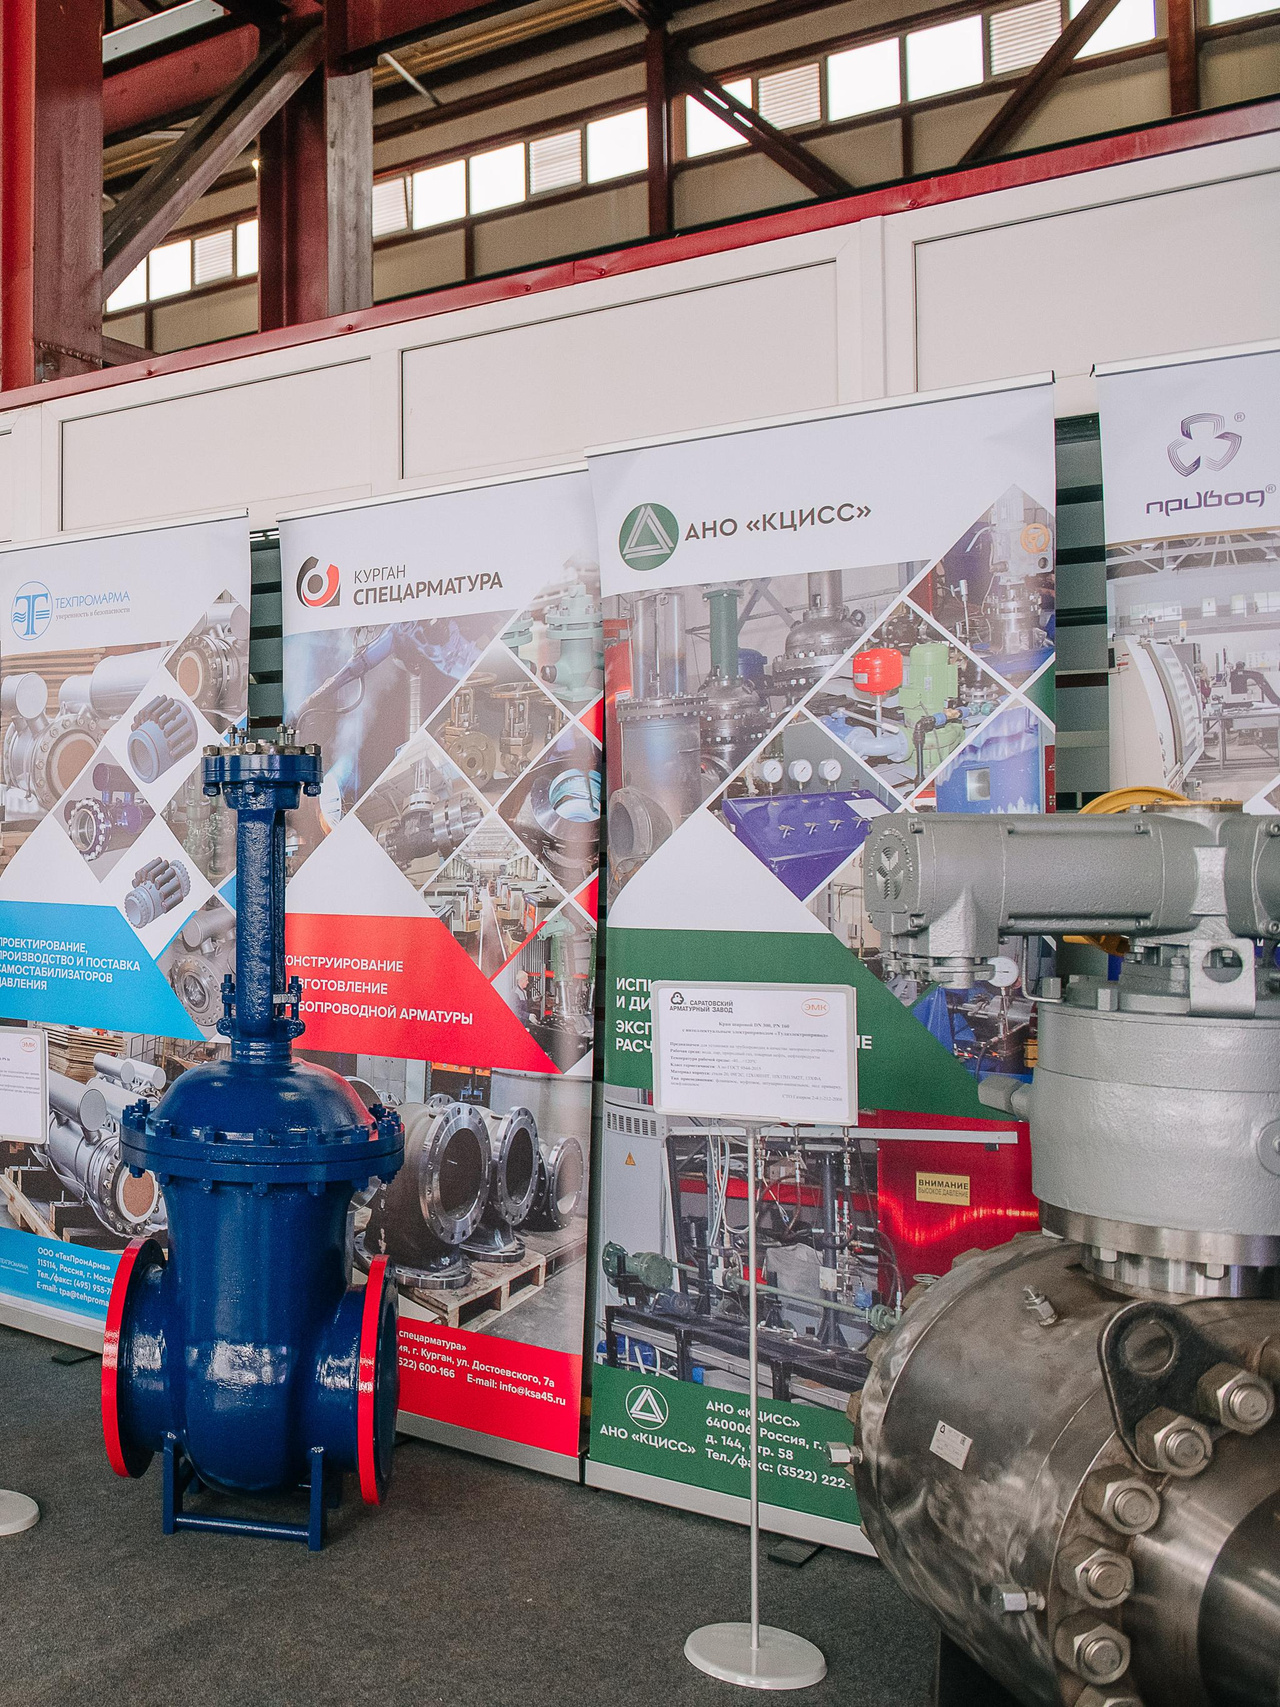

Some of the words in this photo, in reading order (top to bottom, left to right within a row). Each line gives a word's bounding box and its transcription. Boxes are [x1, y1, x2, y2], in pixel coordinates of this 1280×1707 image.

[685, 518, 738, 541] АНО
[746, 502, 872, 532] «КЦИСС»
[354, 564, 406, 584] КУРГАН
[353, 571, 503, 606] СПЕЦАРМАТУРА
[55, 590, 131, 609] ТЕХПРОМАРМА
[55, 611, 89, 621] уверенность
[94, 607, 131, 616] безопасности
[76, 957, 84, 967] И
[85, 957, 141, 971] ПОСТАВКА
[289, 976, 388, 995] ЗГОТОВЛЕНИЕ
[298, 1000, 397, 1019] БОПРОВОДНОЙ
[399, 1007, 473, 1025] АРМАТУРЫ
[616, 995, 625, 1009] И
[669, 1005, 710, 1013] АРМАТУРНЫЙ
[689, 999, 734, 1007] САРАТОВСКИЙ
[805, 1003, 827, 1011] ЭМК
[615, 1037, 653, 1053] РАСЧ
[918, 1179, 969, 1190] ВНИМАНИЕ
[918, 1186, 941, 1196] ВЫСОКОЕ
[942, 1188, 969, 1198] ДАВЛЕНИЕ
[37, 1246, 54, 1257] ООО
[55, 1252, 111, 1271] «ТехПромАрма»
[37, 1258, 58, 1271] 115114,
[59, 1263, 86, 1279] Россия,
[36, 1269, 72, 1285] Тел./факс:
[73, 1279, 91, 1291] (495)
[92, 1284, 112, 1295] 955-7
[36, 1281, 58, 1293] E-mail:
[59, 1287, 109, 1307] tpa@tehproma
[398, 1330, 467, 1351] спецарматура»
[412, 1347, 419, 1356] г.
[420, 1347, 455, 1365] Курган,
[456, 1358, 470, 1367] ул.
[471, 1360, 542, 1386] Достоевского,
[543, 1375, 555, 1388] 7а
[398, 1356, 417, 1371] 522)
[418, 1362, 455, 1379] 600-166
[466, 1373, 498, 1389] E-mail:
[499, 1381, 566, 1407] info@ksa45.ru
[706, 1400, 735, 1415] АНО
[599, 1424, 628, 1440] АНО
[631, 1431, 696, 1455] «КЦИСС»
[705, 1434, 718, 1445] д.
[721, 1435, 746, 1452] 144,
[749, 1444, 775, 1457] тр.
[777, 1447, 794, 1461] 58
[759, 1427, 810, 1450] Россия,
[813, 1440, 823, 1451] г.
[777, 1463, 818, 1484] (3522)
[821, 1474, 853, 1490] 222-
